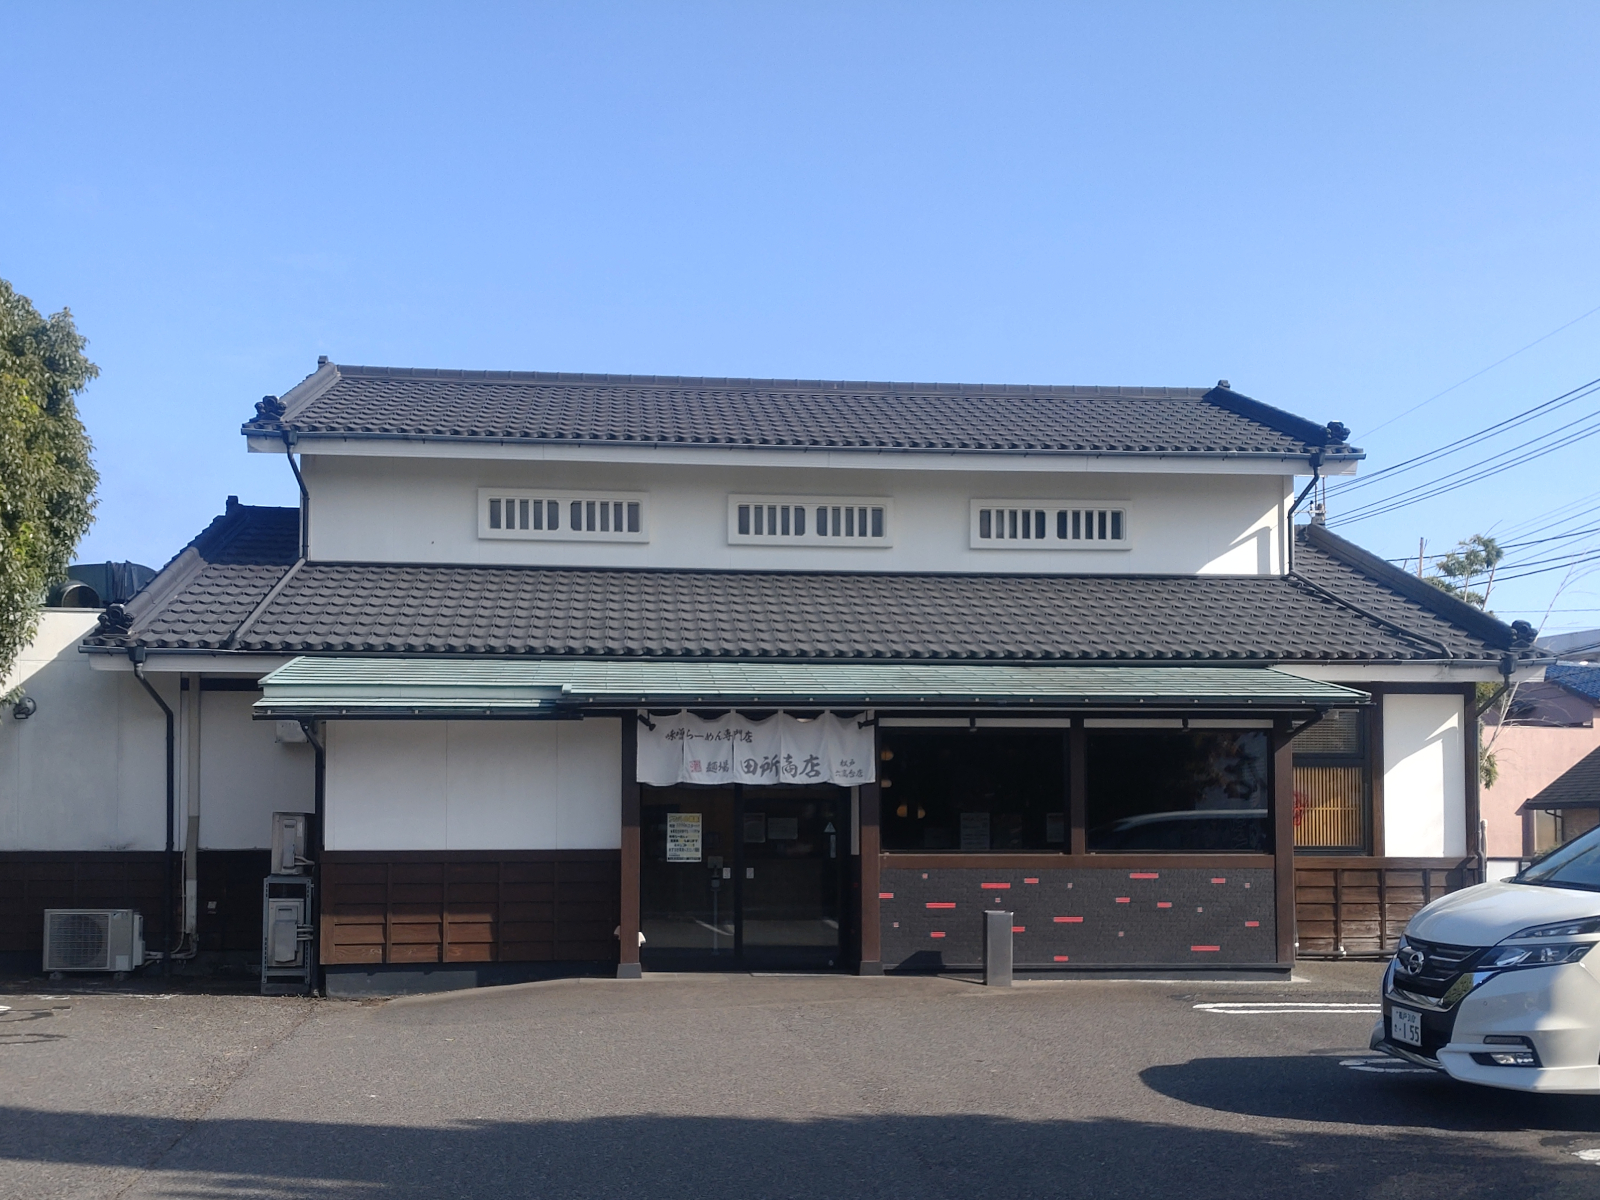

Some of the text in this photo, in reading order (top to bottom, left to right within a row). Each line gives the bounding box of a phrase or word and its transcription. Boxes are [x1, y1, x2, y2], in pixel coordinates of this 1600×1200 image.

[665, 728, 753, 743] 味噌らーめん専門店
[740, 754, 821, 778] 田所商店
